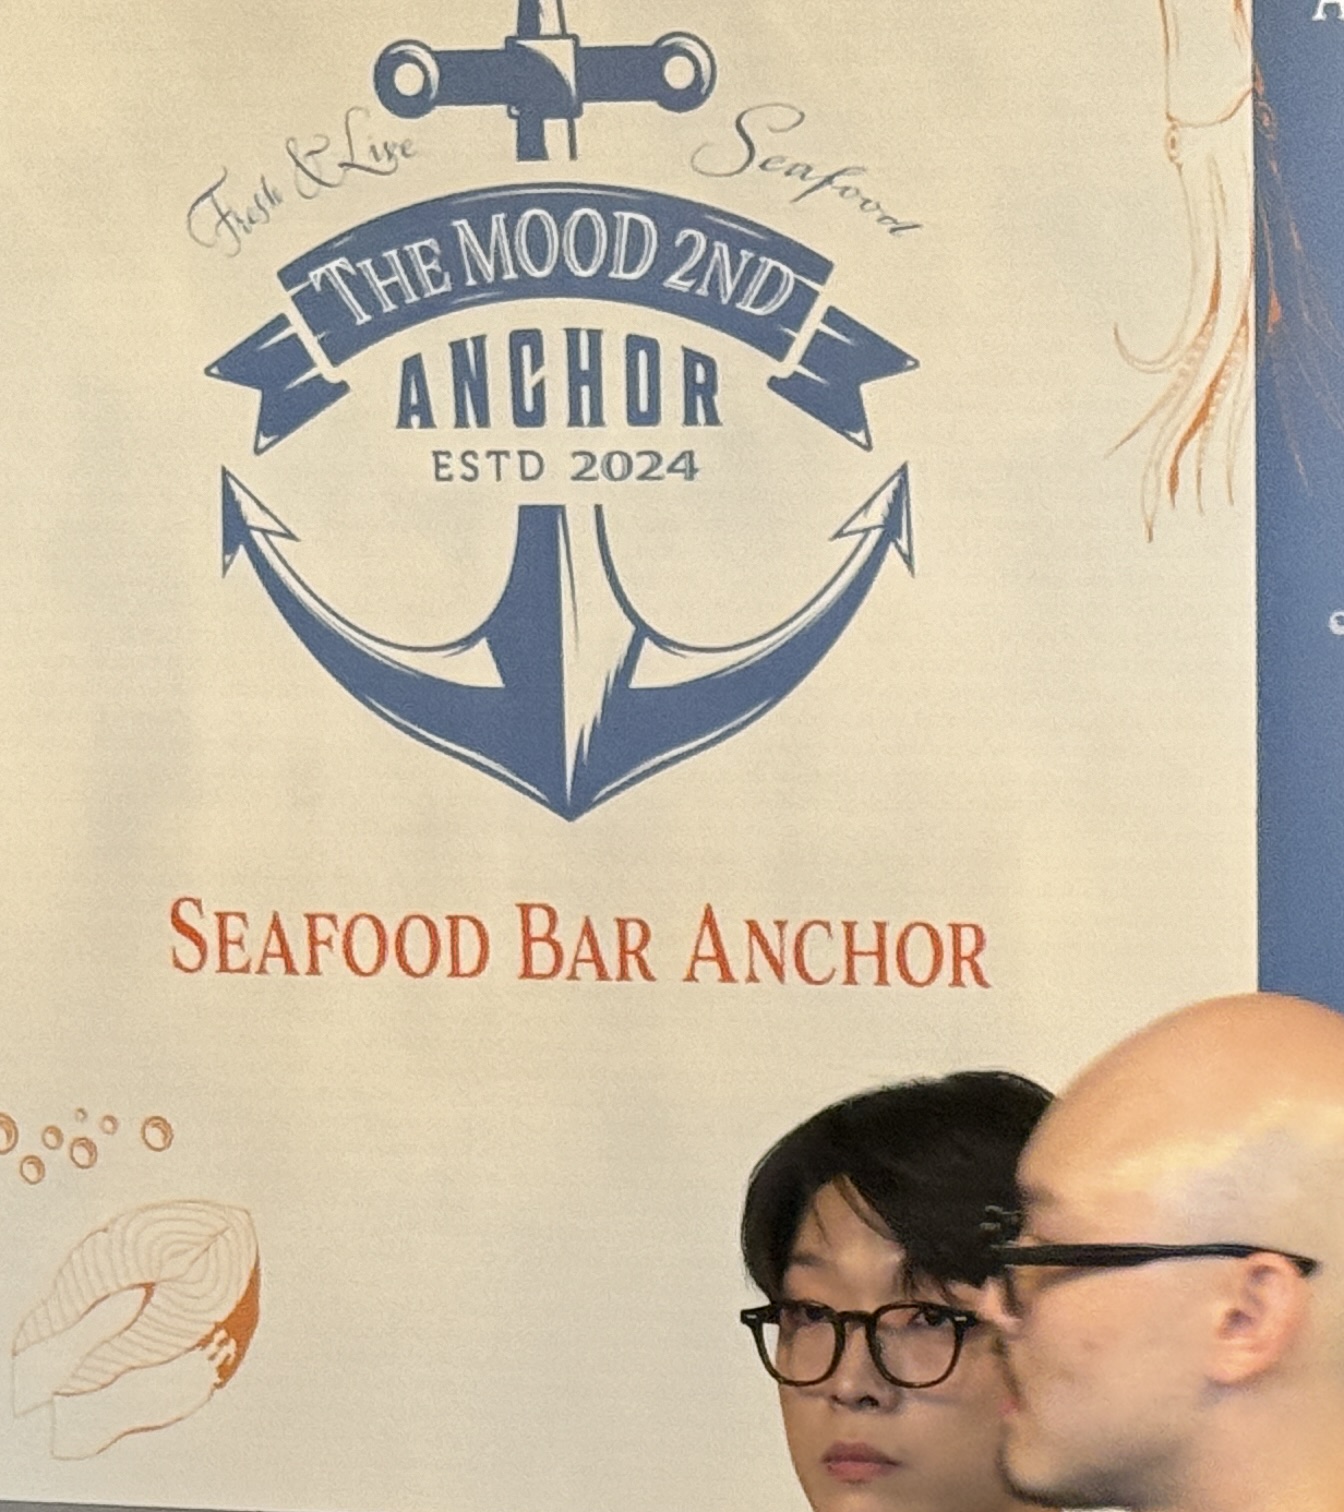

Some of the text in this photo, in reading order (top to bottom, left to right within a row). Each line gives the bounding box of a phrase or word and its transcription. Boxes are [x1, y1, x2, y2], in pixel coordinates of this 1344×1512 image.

[187, 106, 415, 258] Fresh & Live
[691, 103, 923, 237] Seafood
[309, 208, 796, 326] THE MOOD 2ND
[395, 327, 723, 429] ANCHOR
[432, 449, 699, 482] ESTD 2024
[169, 896, 991, 990] SEAFOOD BAR ANCHOR
